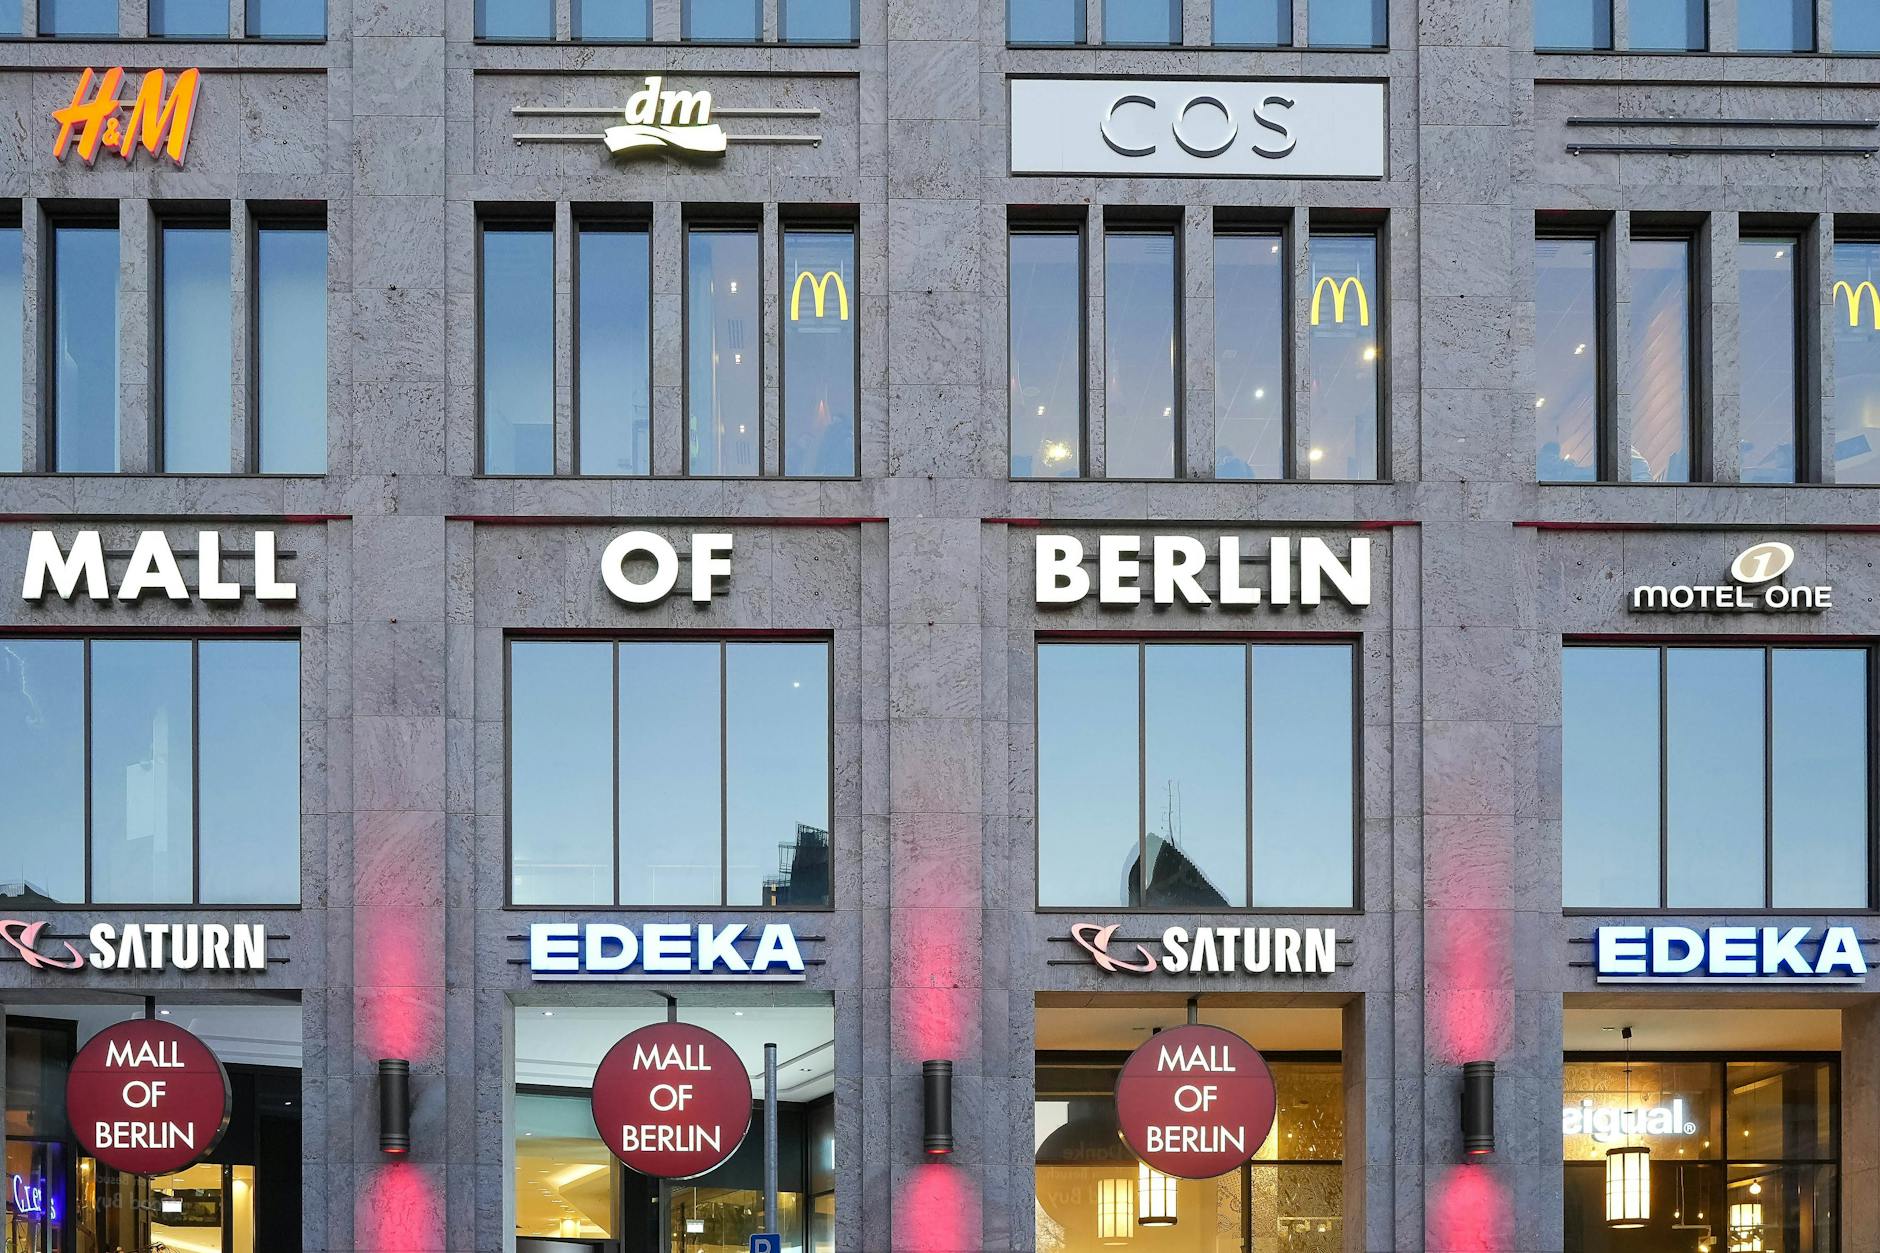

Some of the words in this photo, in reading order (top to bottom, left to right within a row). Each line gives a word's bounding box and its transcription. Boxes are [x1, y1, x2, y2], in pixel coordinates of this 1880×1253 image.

[624, 75, 713, 126] dm
[51, 66, 201, 168] H&M
[1099, 94, 1297, 159] COS
[21, 529, 298, 602] MALL
[600, 529, 734, 606] OF
[1034, 534, 1372, 608] BERLIN
[1633, 584, 1755, 610] MOTEL
[1764, 584, 1833, 609] ONE
[88, 923, 267, 972] SATURN
[529, 922, 805, 973] EDEKA
[1161, 927, 1337, 975] SATURN
[1597, 926, 1868, 976] EDEKA
[105, 1040, 185, 1069] MALL
[632, 1043, 712, 1071] MALL
[1157, 1044, 1236, 1073] MALL
[122, 1080, 167, 1109] OF
[649, 1084, 694, 1112] OF
[1173, 1085, 1218, 1113] OF
[95, 1121, 195, 1149] BERLIN
[622, 1124, 721, 1153] BERLIN
[1146, 1125, 1246, 1154] BERLIN
